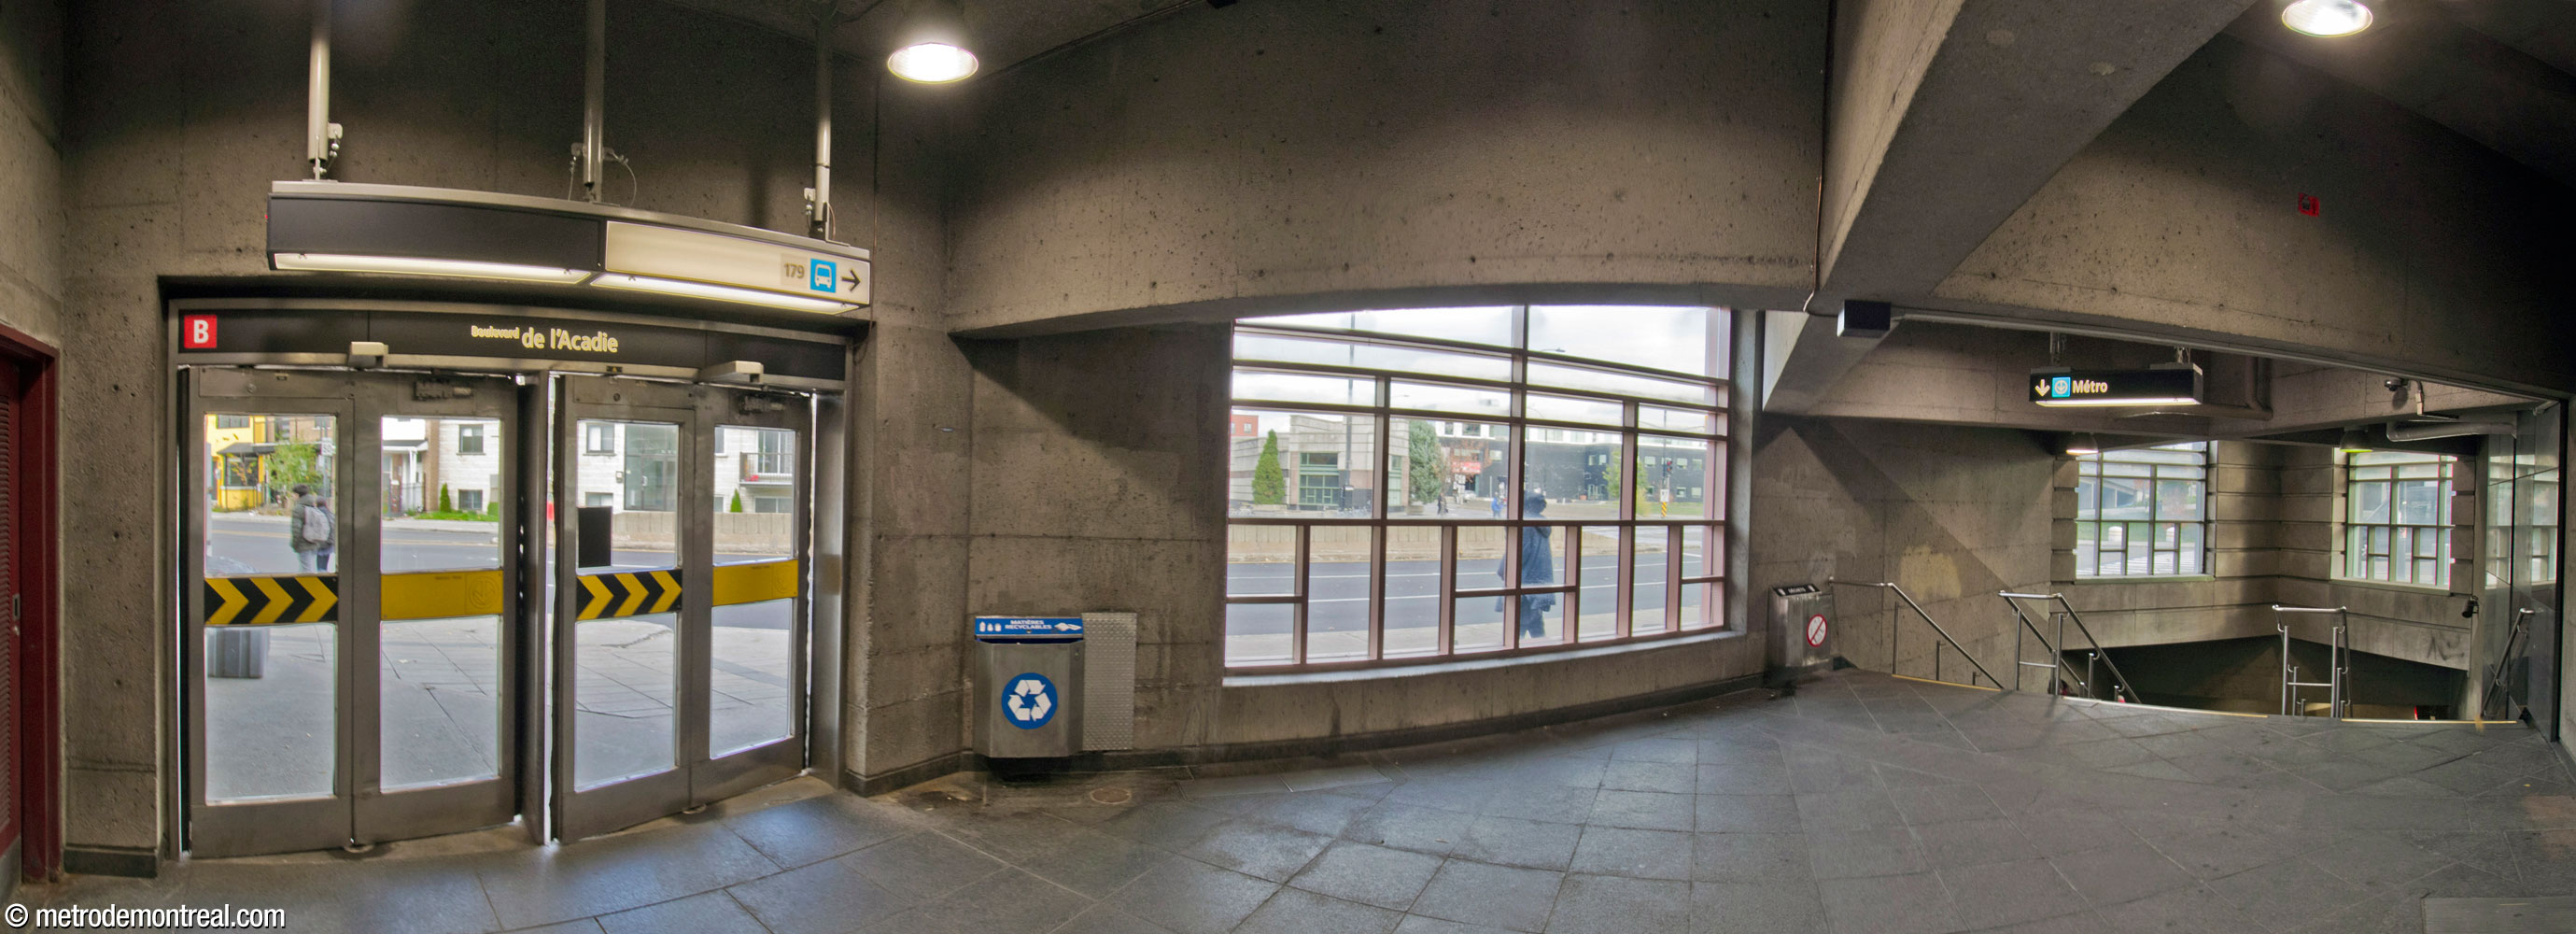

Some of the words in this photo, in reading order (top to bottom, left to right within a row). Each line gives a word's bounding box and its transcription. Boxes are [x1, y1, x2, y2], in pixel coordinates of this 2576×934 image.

[784, 262, 805, 279] 179
[193, 319, 209, 344] B
[471, 325, 520, 339] Boulevard
[521, 327, 545, 349] de
[550, 328, 619, 353] l'Acadie
[2072, 379, 2108, 394] Métro
